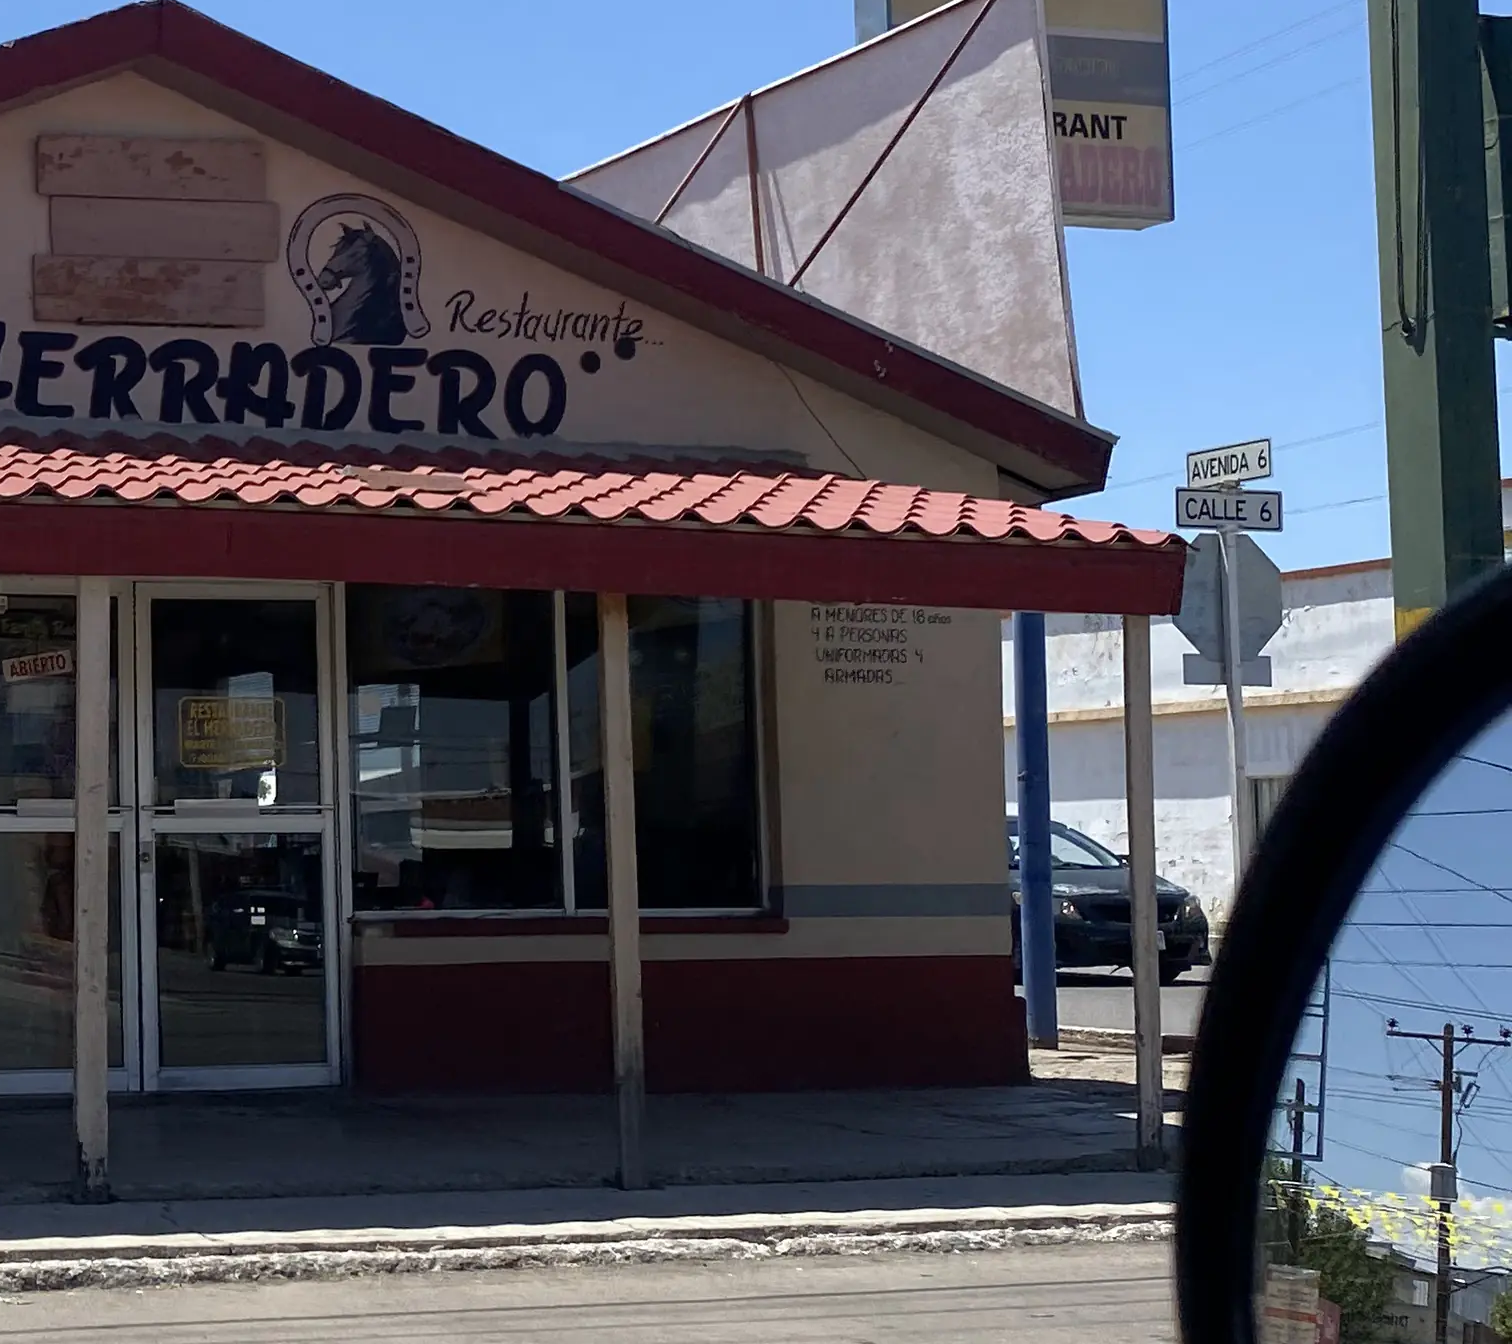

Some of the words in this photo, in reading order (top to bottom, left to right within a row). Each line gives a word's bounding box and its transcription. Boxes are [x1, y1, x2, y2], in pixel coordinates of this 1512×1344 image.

[1191, 452, 1249, 482] AVENIDA
[1257, 449, 1267, 469] 6
[1185, 498, 1247, 521] CALLE
[1260, 501, 1272, 522] 6
[825, 607, 888, 622] MENORES
[890, 607, 909, 623] DE
[911, 609, 926, 624] 18
[825, 626, 834, 642] A
[839, 626, 908, 644] PERSONAS
[815, 647, 908, 664] UNIFORMADAS
[10, 654, 67, 677] ABIERTO
[823, 667, 894, 684] ARMADAS
